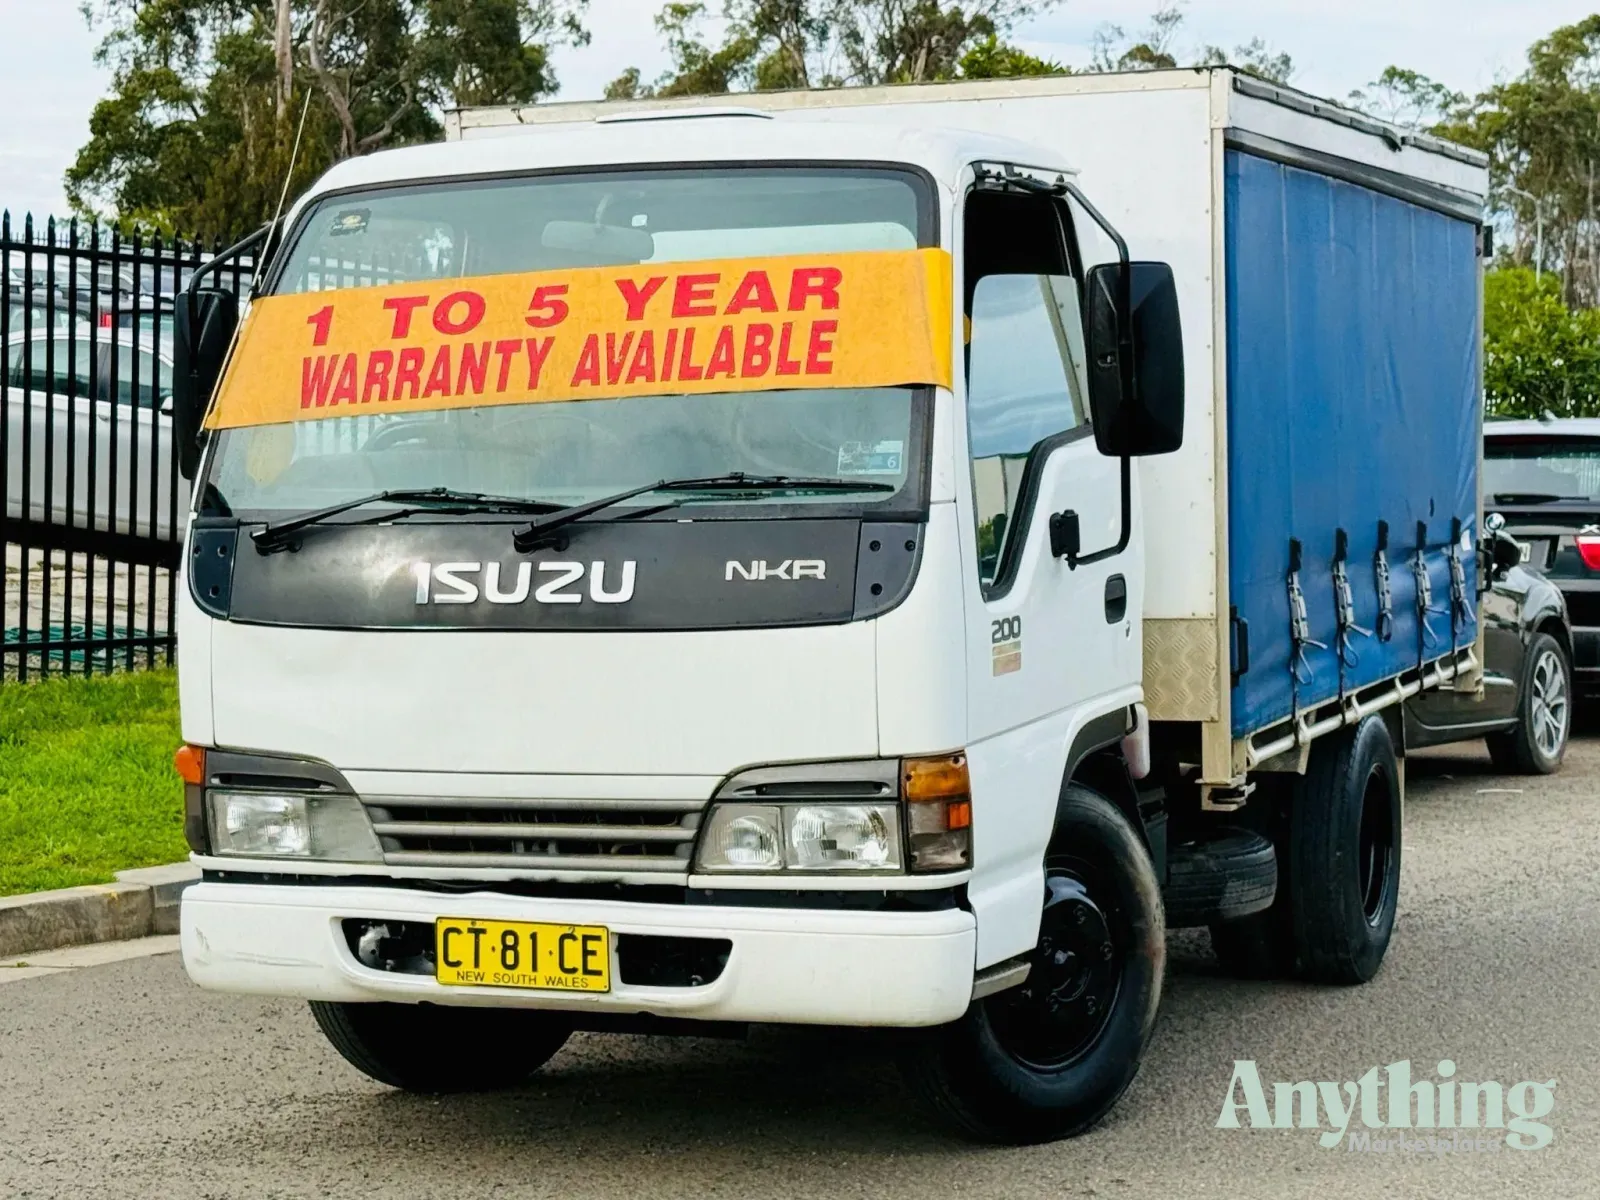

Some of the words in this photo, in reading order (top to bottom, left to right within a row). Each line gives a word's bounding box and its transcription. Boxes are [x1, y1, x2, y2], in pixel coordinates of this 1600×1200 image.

[307, 305, 333, 346] 1
[383, 291, 486, 338] TO
[525, 284, 571, 328] 5
[614, 266, 843, 320] YEAR
[300, 336, 555, 409] WARRANTY
[570, 319, 838, 388] AVAILABLE
[414, 560, 637, 605] ISUZU
[724, 559, 827, 581] NKR
[991, 615, 1021, 644] 200
[456, 970, 485, 982] NEW
[493, 973, 537, 985] SOUTH
[545, 975, 589, 988] WALES
